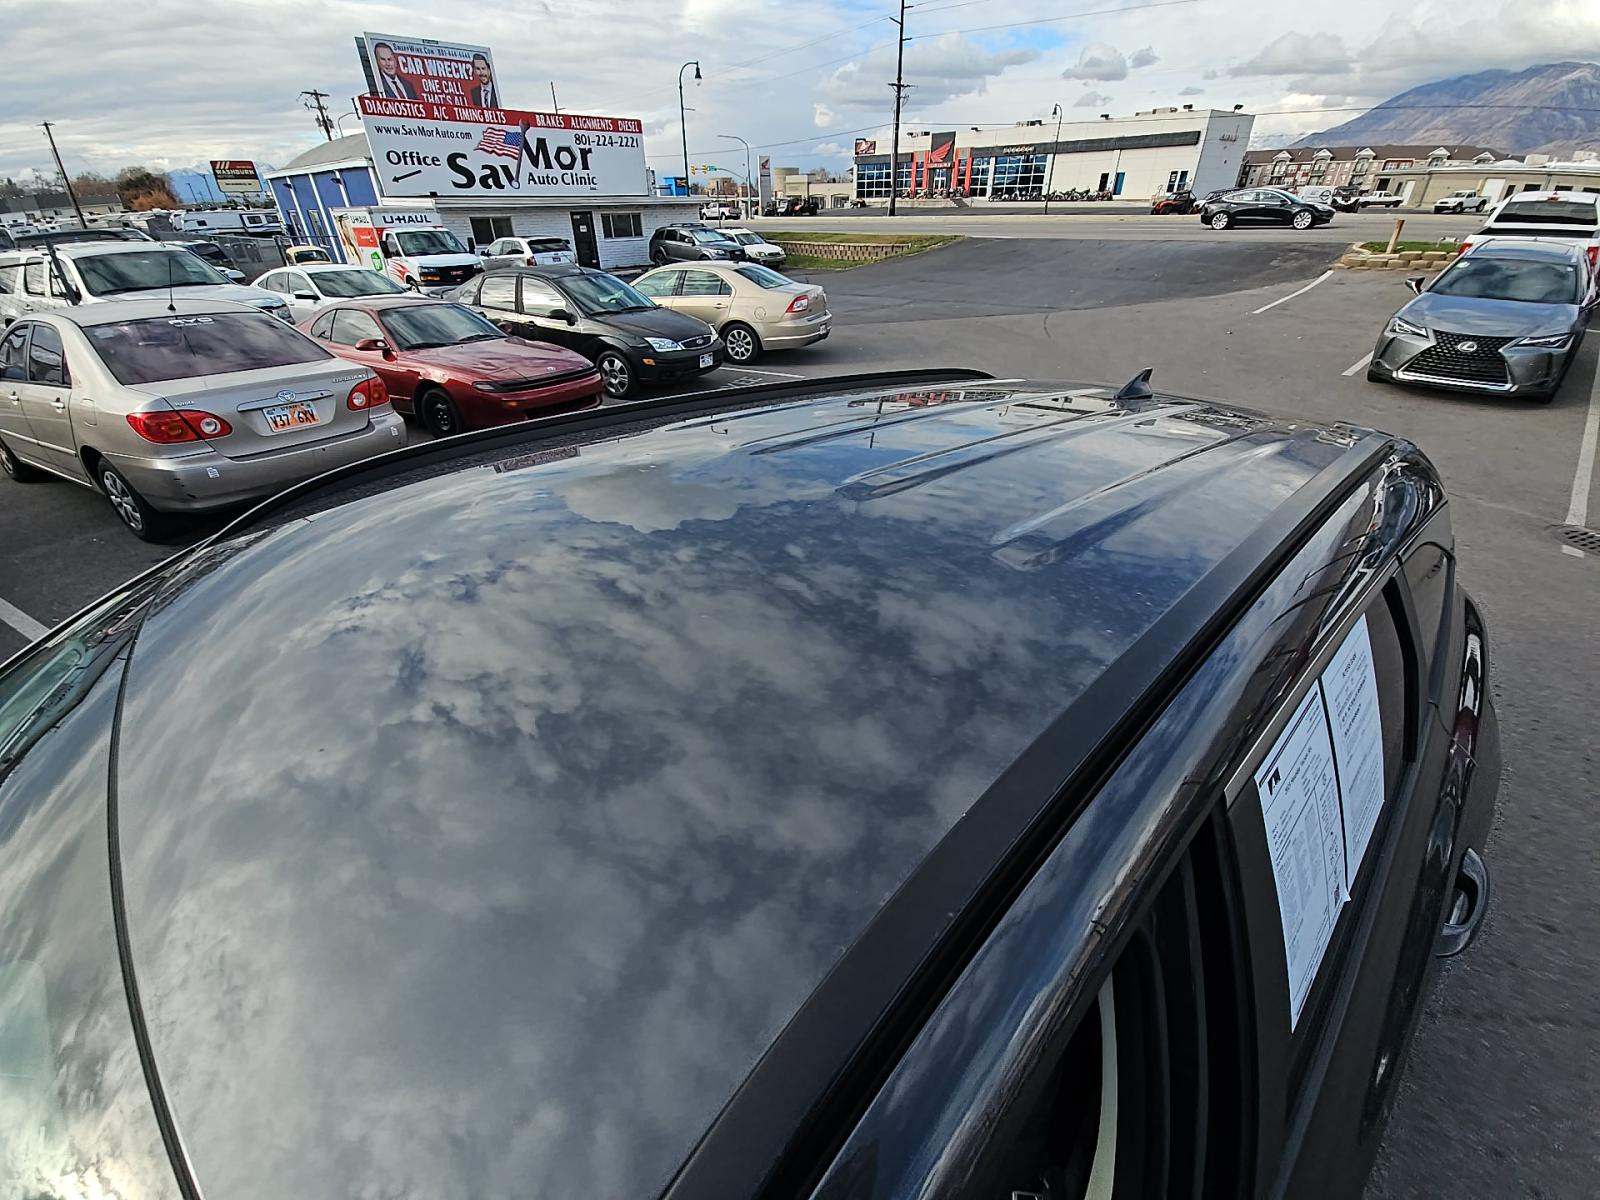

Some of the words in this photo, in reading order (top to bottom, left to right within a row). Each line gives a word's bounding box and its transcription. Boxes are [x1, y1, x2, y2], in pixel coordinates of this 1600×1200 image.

[397, 56, 424, 75] CAR
[424, 58, 473, 80] WRECK?
[422, 79, 441, 92] ONE
[442, 80, 464, 95] CALL
[421, 93, 453, 105] THAT'S
[453, 96, 469, 107] ALL
[364, 100, 426, 117] DIAGNOSTICS
[433, 106, 449, 119] A/C
[454, 107, 483, 122] TIMING
[484, 108, 506, 124] BELTS
[535, 114, 565, 128] BRAKES
[571, 117, 613, 131] ALIGNMENTS
[618, 120, 639, 132] DIESEL
[374, 125, 473, 140] www.SavMorAuto.com
[574, 133, 639, 148] 801-224-2221
[385, 150, 441, 166] Office
[527, 173, 558, 185] Auto
[561, 172, 598, 187] Clinic
[382, 214, 432, 224] U-HAUL
[270, 413, 290, 429] V37
[297, 408, 317, 424] 6XV
